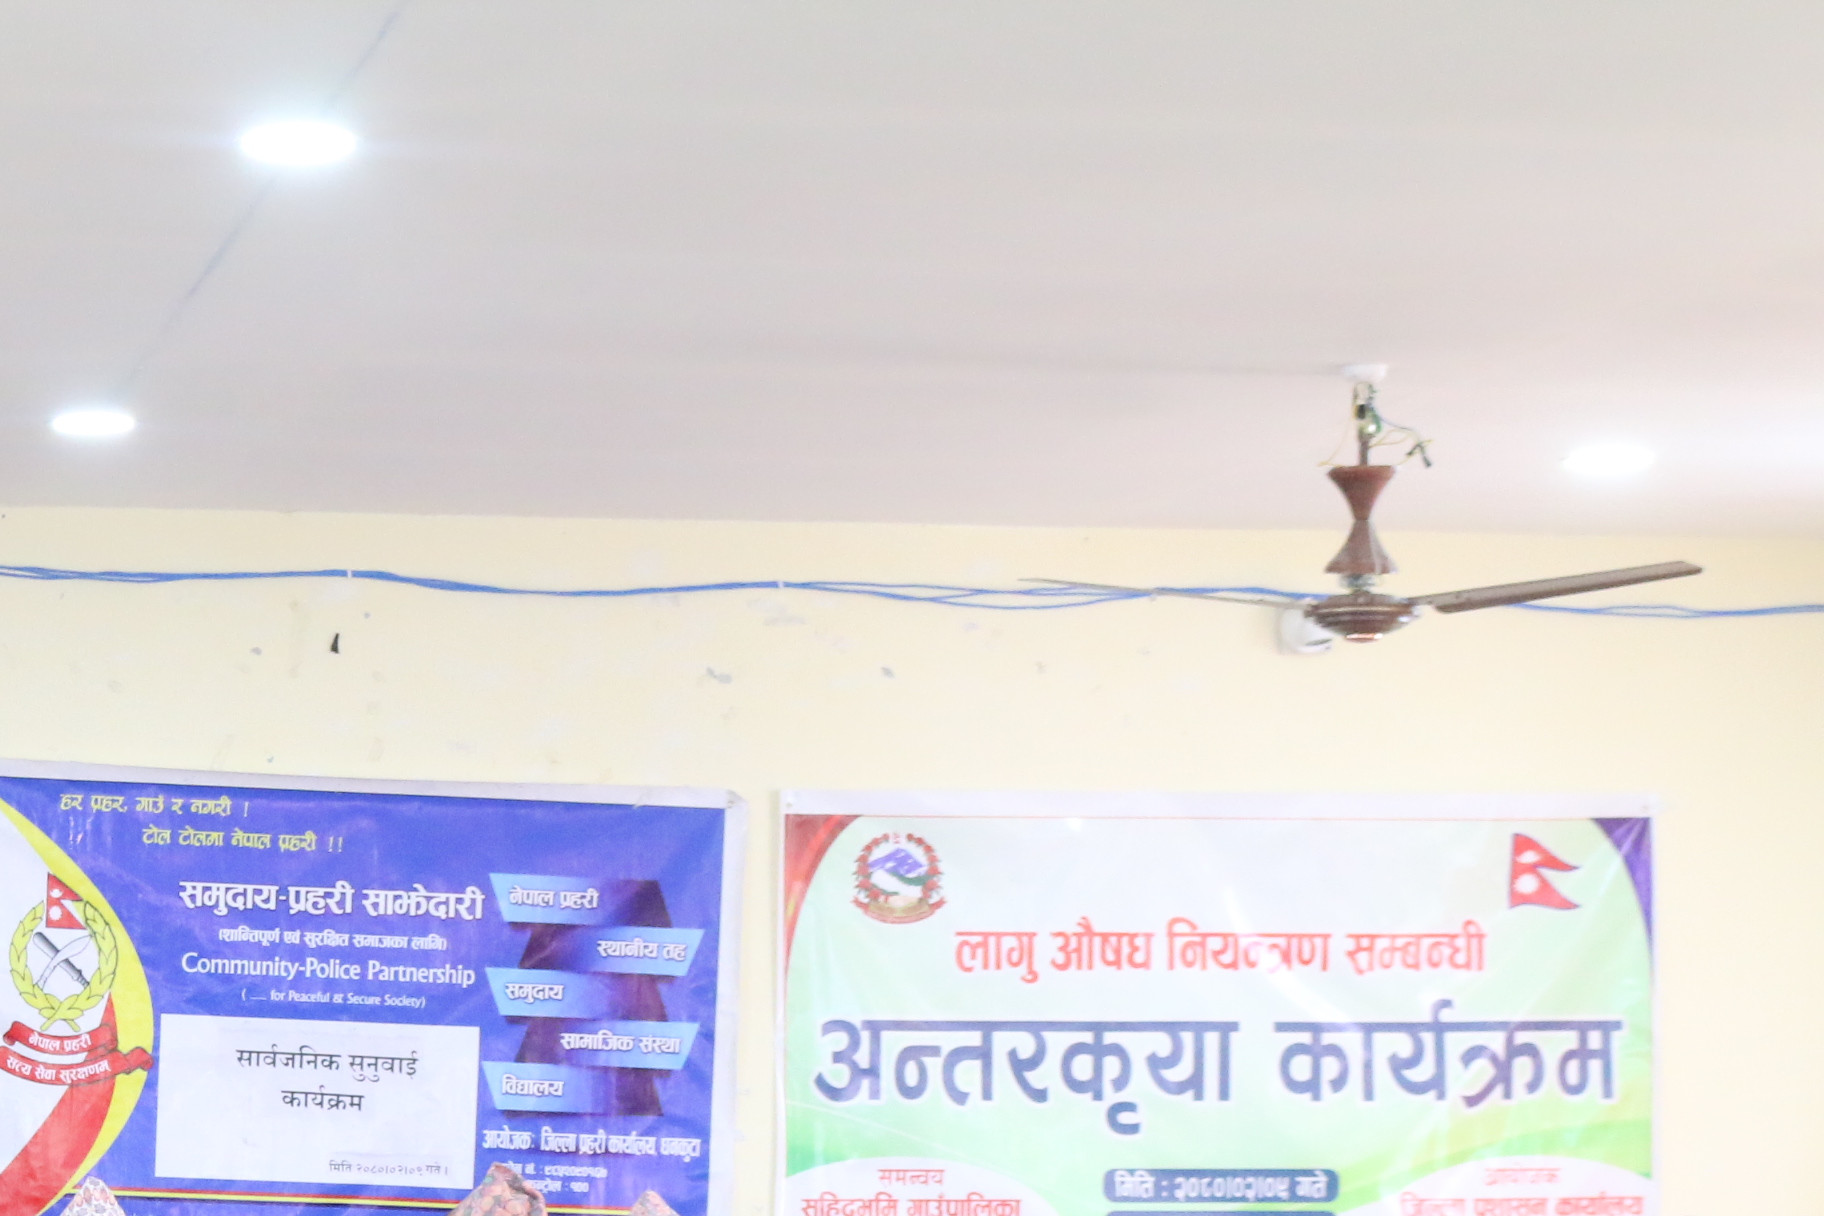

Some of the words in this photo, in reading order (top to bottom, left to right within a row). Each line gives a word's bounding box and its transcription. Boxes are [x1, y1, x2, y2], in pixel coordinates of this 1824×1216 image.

[60, 794, 83, 810] हर
[172, 797, 184, 814] र
[190, 795, 232, 816] नगरी
[142, 824, 171, 845] टोल
[178, 825, 224, 847] टोलमा
[231, 827, 271, 849] नेपाल
[278, 830, 317, 852] प्रहरी
[179, 880, 355, 916] समुदाय-प्रहरी
[362, 883, 486, 920] साझेदारी
[509, 885, 555, 907] नेपाल
[560, 888, 600, 909] प्रहरी
[304, 928, 349, 949] सुरक्षित
[352, 933, 408, 949] समाजका
[597, 937, 658, 958] स्थानीय
[662, 942, 687, 961] तह
[955, 930, 1039, 984] लागु
[1166, 915, 1332, 974] नियन्त्रण
[1345, 918, 1488, 975] सम्बन्धी
[181, 951, 361, 981] Community-Police
[367, 959, 476, 988] Partnership
[270, 989, 285, 1001] for
[288, 990, 330, 1004] Peaceful
[347, 993, 381, 1006] Secure
[505, 982, 564, 1003] समुदाय
[28, 1031, 61, 1050] नेपाल
[63, 1033, 91, 1052] प्रहरी
[560, 1029, 635, 1052] सामाजिक
[639, 1034, 681, 1054] संस्था
[6, 1055, 33, 1076] सत्य
[35, 1065, 56, 1081] सेवा
[236, 1043, 341, 1071] सार्वजनिक
[348, 1050, 419, 1083] सुनुवाई
[813, 1017, 1239, 1136] अन्तरकृया
[1274, 998, 1624, 1109] कार्यक्रम
[501, 1073, 564, 1096] विद्यालय
[281, 1085, 365, 1111] कार्यक्रम
[540, 1126, 577, 1154] जिल्ला
[578, 1128, 606, 1156] प्रहरी
[329, 1159, 352, 1173] मिति
[878, 1168, 945, 1186] समन्वय
